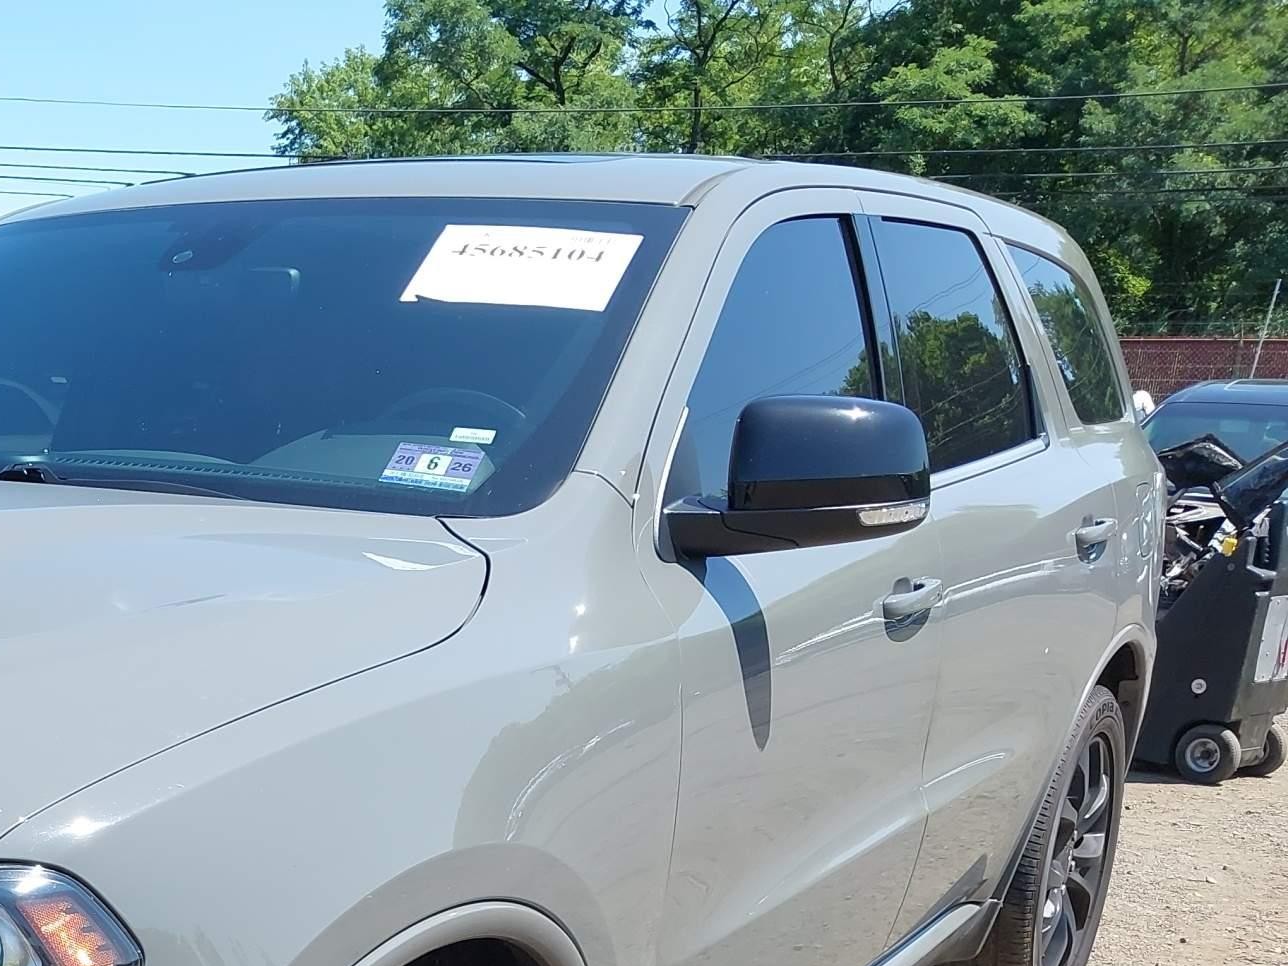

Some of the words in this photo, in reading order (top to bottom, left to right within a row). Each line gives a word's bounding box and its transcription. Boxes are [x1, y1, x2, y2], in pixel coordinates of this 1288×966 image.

[451, 242, 605, 263] 45685104
[395, 454, 415, 466] 20
[427, 456, 440, 471] 6
[450, 462, 473, 473] 26
